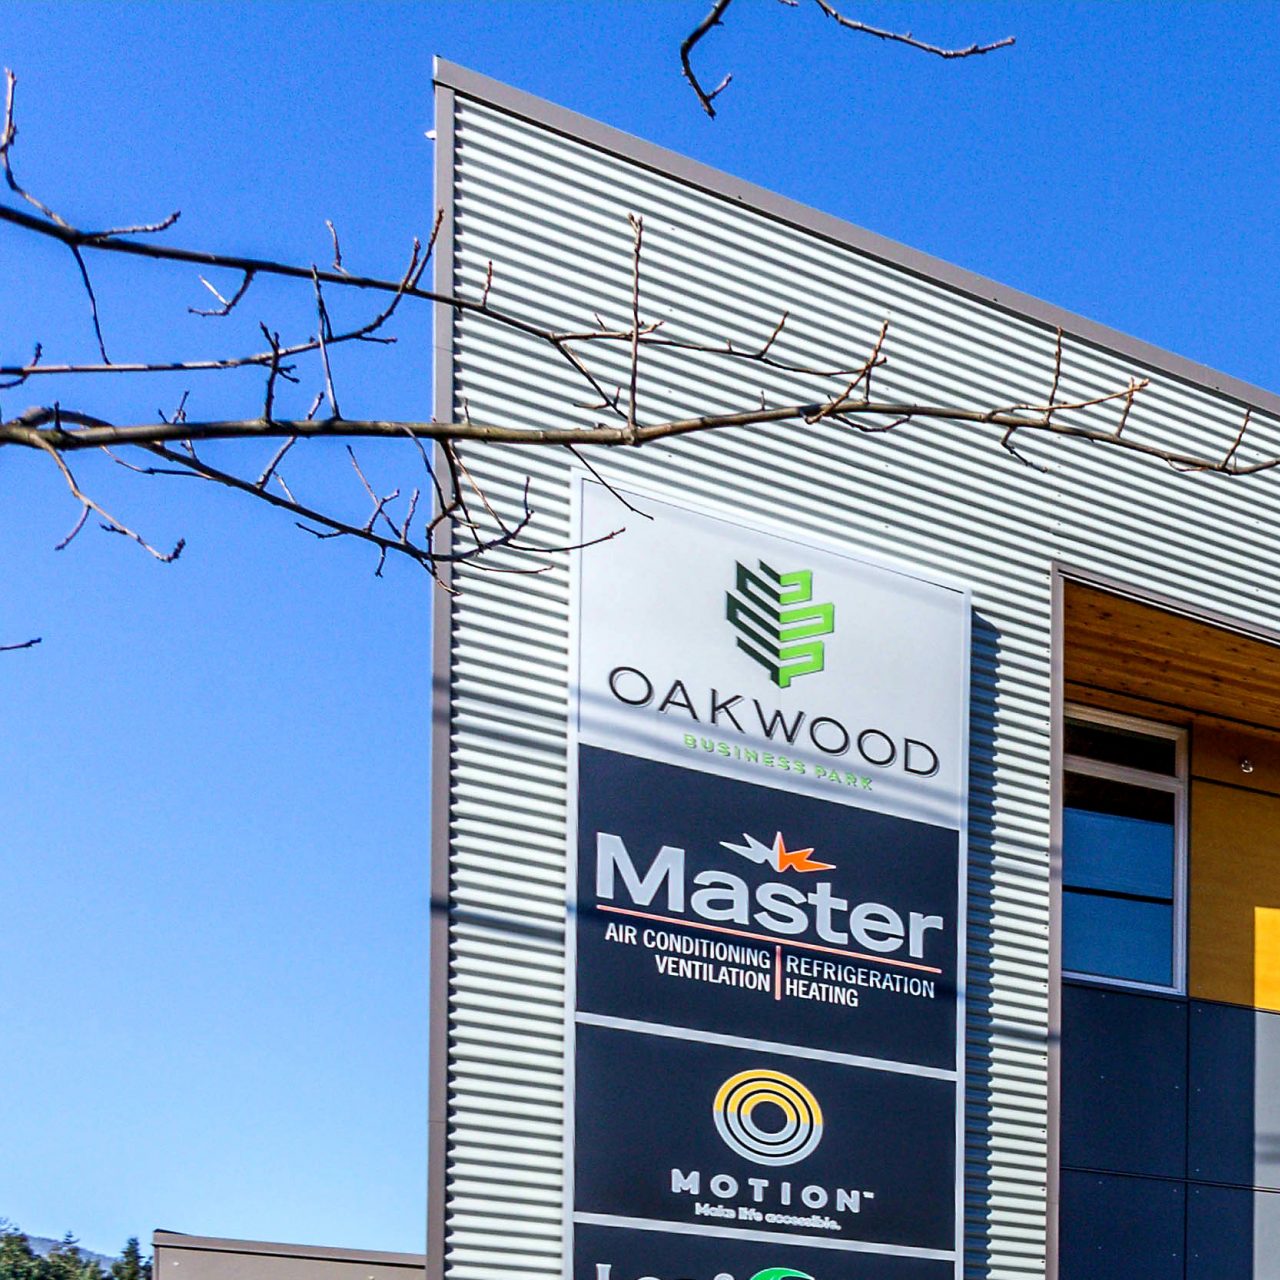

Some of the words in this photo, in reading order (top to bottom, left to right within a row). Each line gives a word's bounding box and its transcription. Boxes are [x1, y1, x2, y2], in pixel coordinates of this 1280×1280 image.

[608, 665, 940, 778] OAKWOOD
[683, 733, 806, 775] BUSINESS
[814, 763, 874, 791] PARK
[595, 831, 944, 959] Master
[604, 922, 638, 946] AIR
[642, 929, 771, 969] CONDITIONING
[654, 954, 771, 993] VENTILATION
[785, 954, 936, 999] REFRIGERATION
[785, 978, 859, 1008] HEATING
[694, 1201, 737, 1219] Make
[738, 1206, 764, 1222] life
